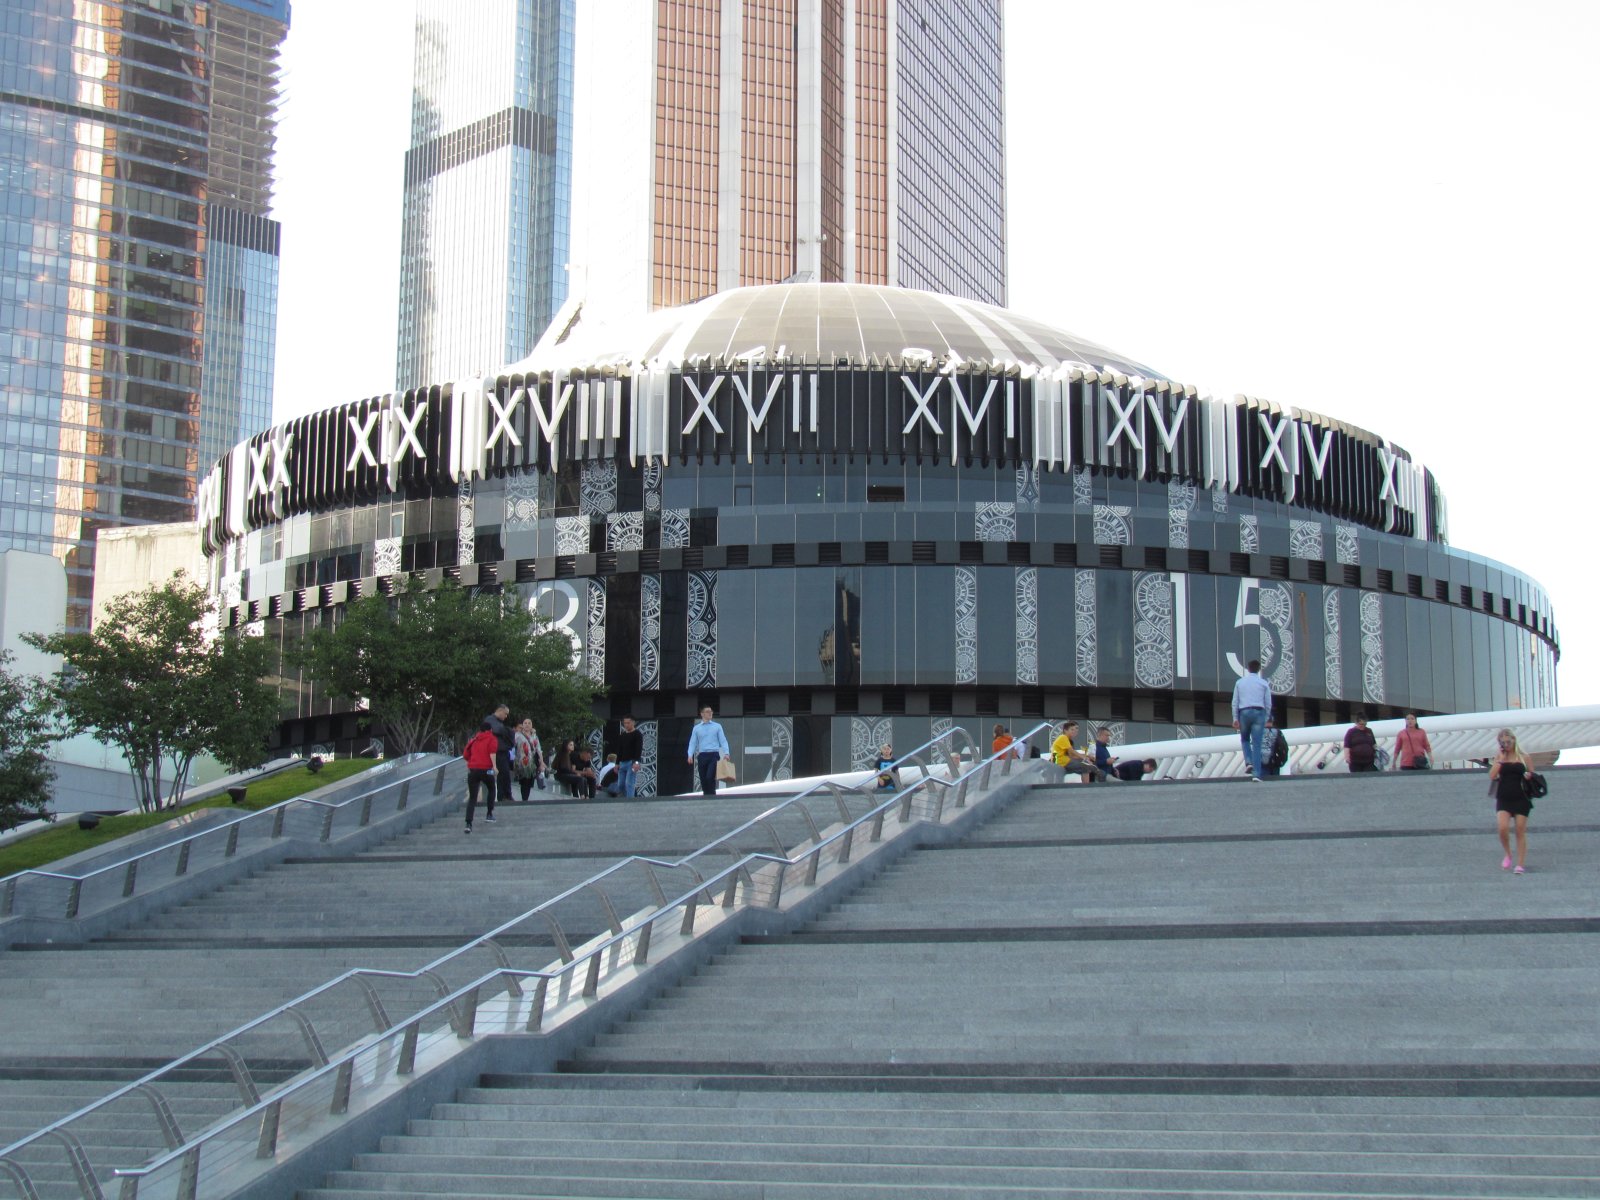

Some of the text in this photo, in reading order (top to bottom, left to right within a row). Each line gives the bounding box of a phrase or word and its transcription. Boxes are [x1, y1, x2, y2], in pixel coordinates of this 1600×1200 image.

[347, 401, 427, 471] XIX
[485, 380, 621, 449] XVIII
[682, 374, 817, 434] XVII
[901, 375, 1015, 438] XVI
[1105, 389, 1189, 453] XV
[248, 433, 294, 499] XX
[1258, 413, 1333, 481] XIV
